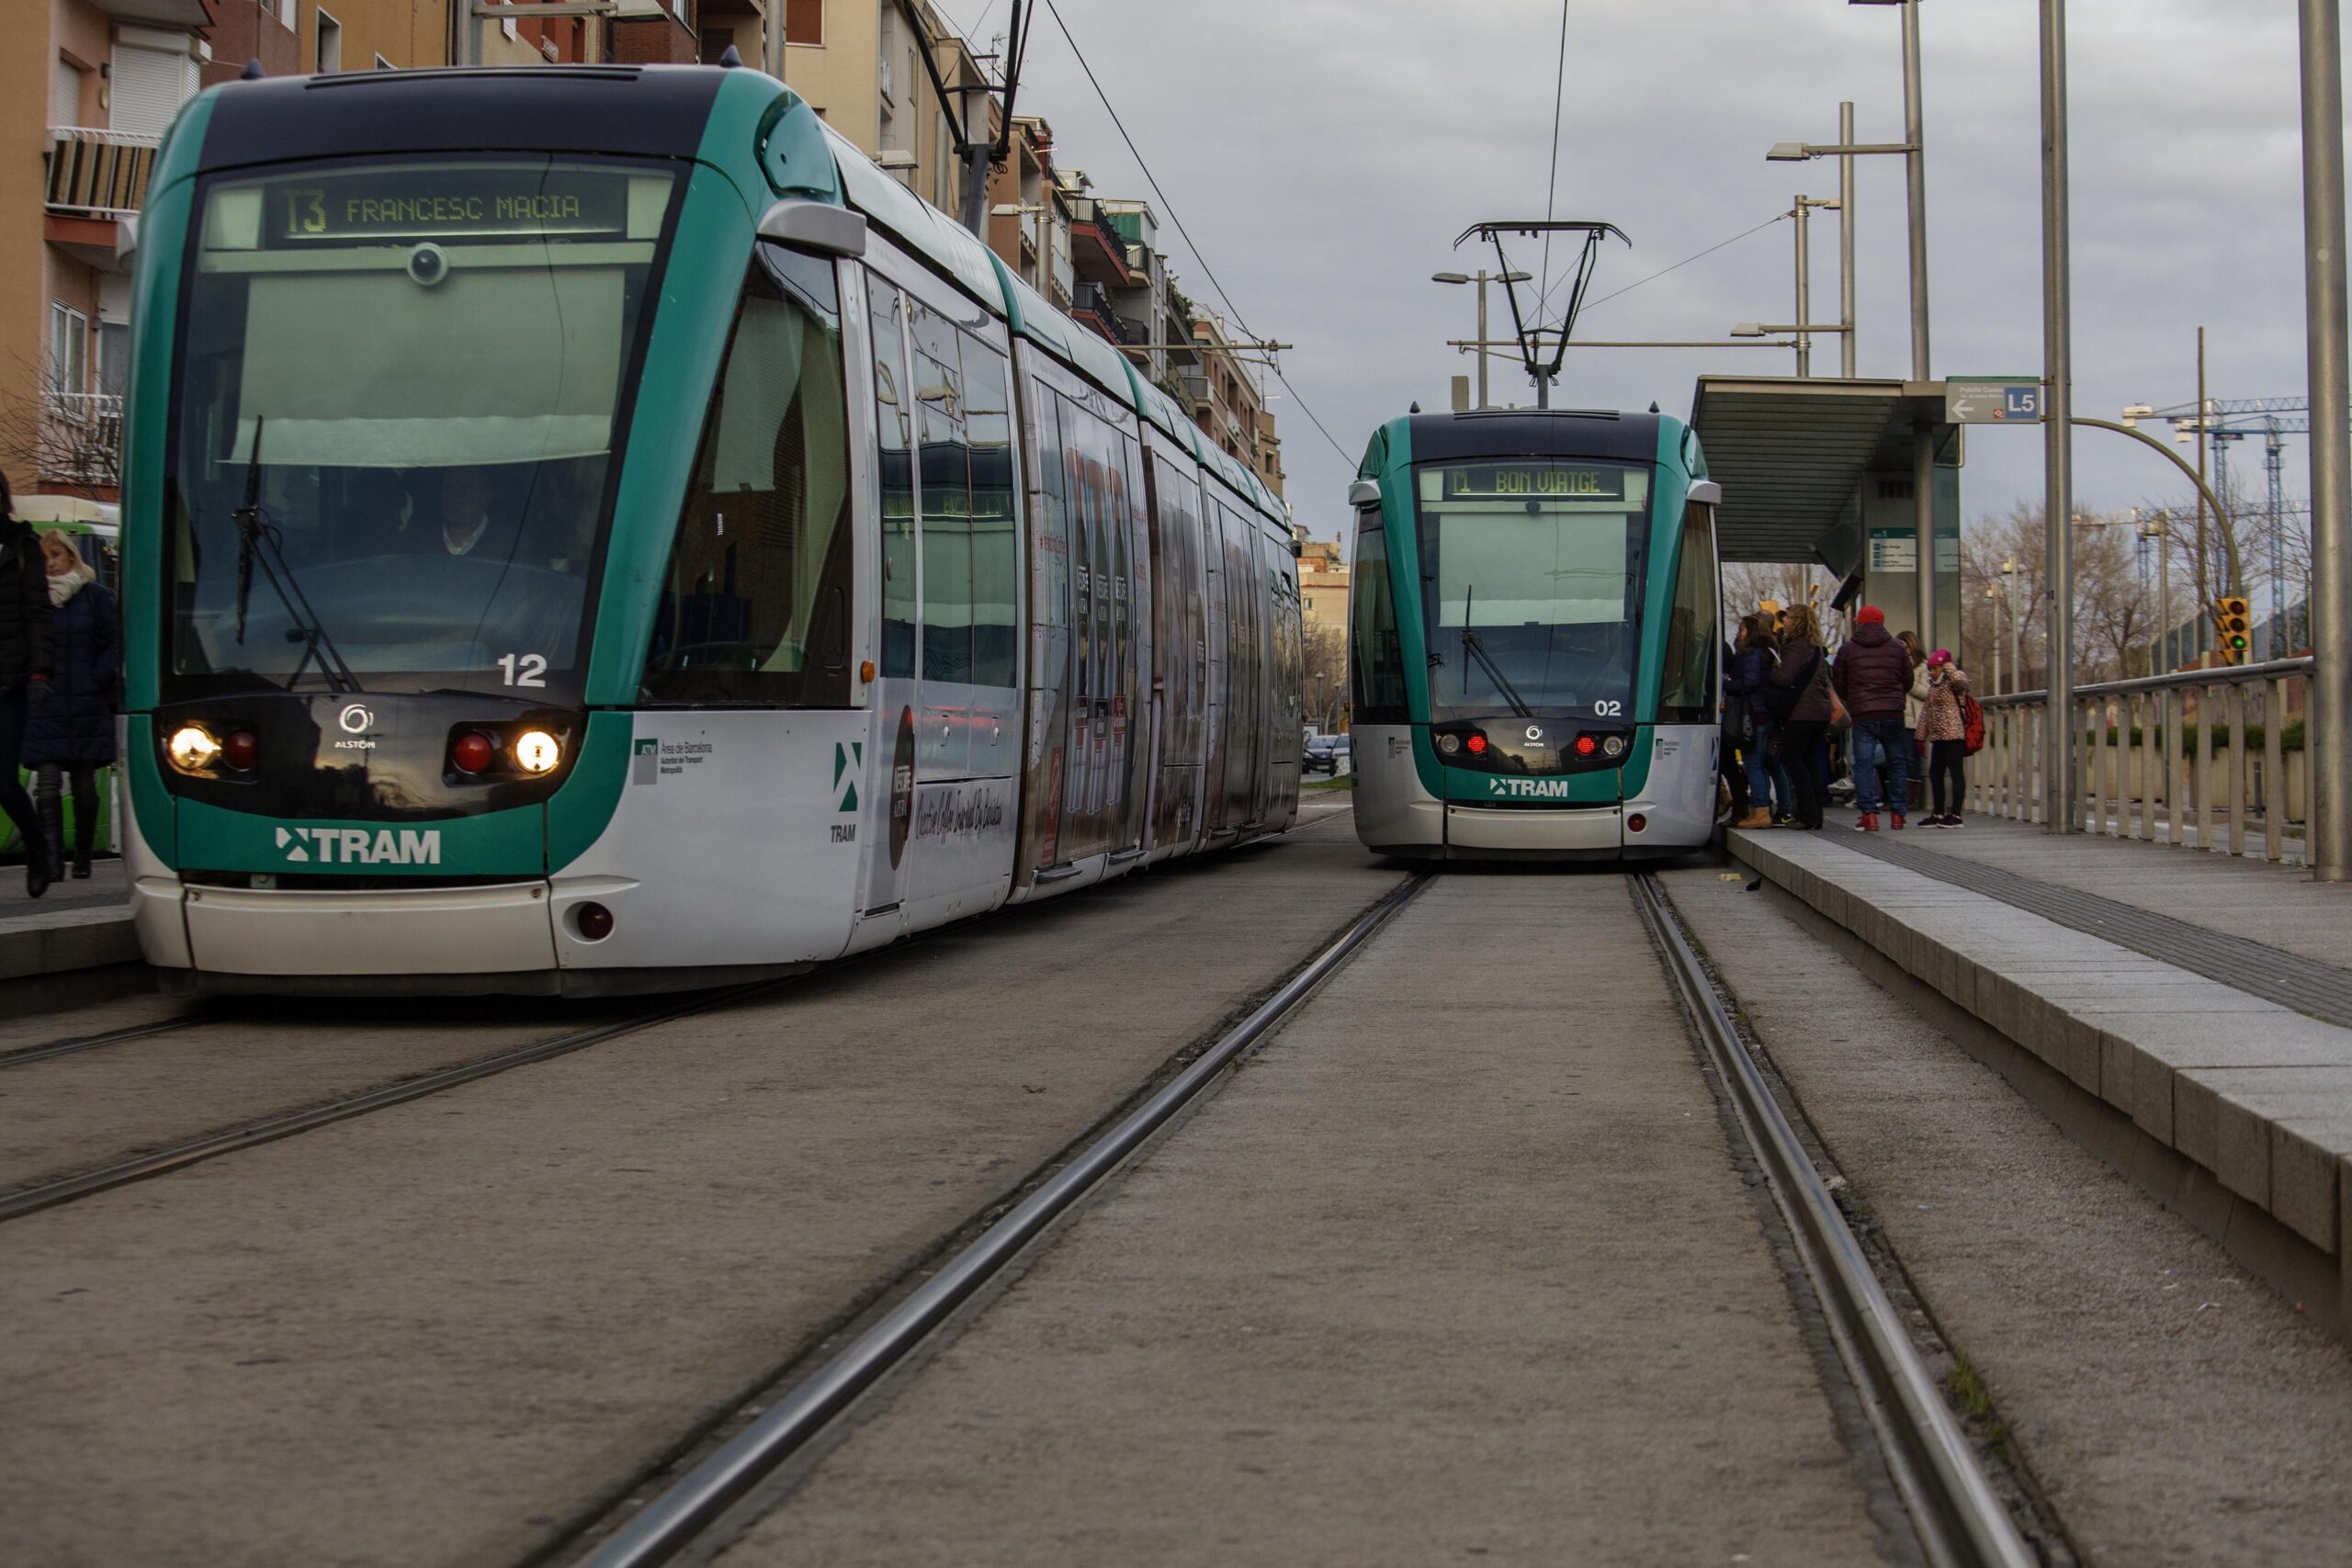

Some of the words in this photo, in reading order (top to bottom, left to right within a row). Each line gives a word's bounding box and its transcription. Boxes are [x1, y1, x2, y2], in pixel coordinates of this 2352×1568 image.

[288, 187, 327, 232] T3
[346, 195, 483, 223] FRANCESC
[496, 195, 581, 220] MACIA
[2007, 393, 2035, 412] L5
[1495, 470, 1532, 493] BON
[1536, 471, 1600, 493] VIATGE
[497, 653, 548, 688] 12
[1594, 700, 1622, 716] 02
[676, 741, 684, 753] de
[684, 741, 713, 754] Barcelona
[1507, 780, 1568, 797] TRAM
[831, 824, 856, 843] TRAM
[311, 829, 441, 864] TRAM
